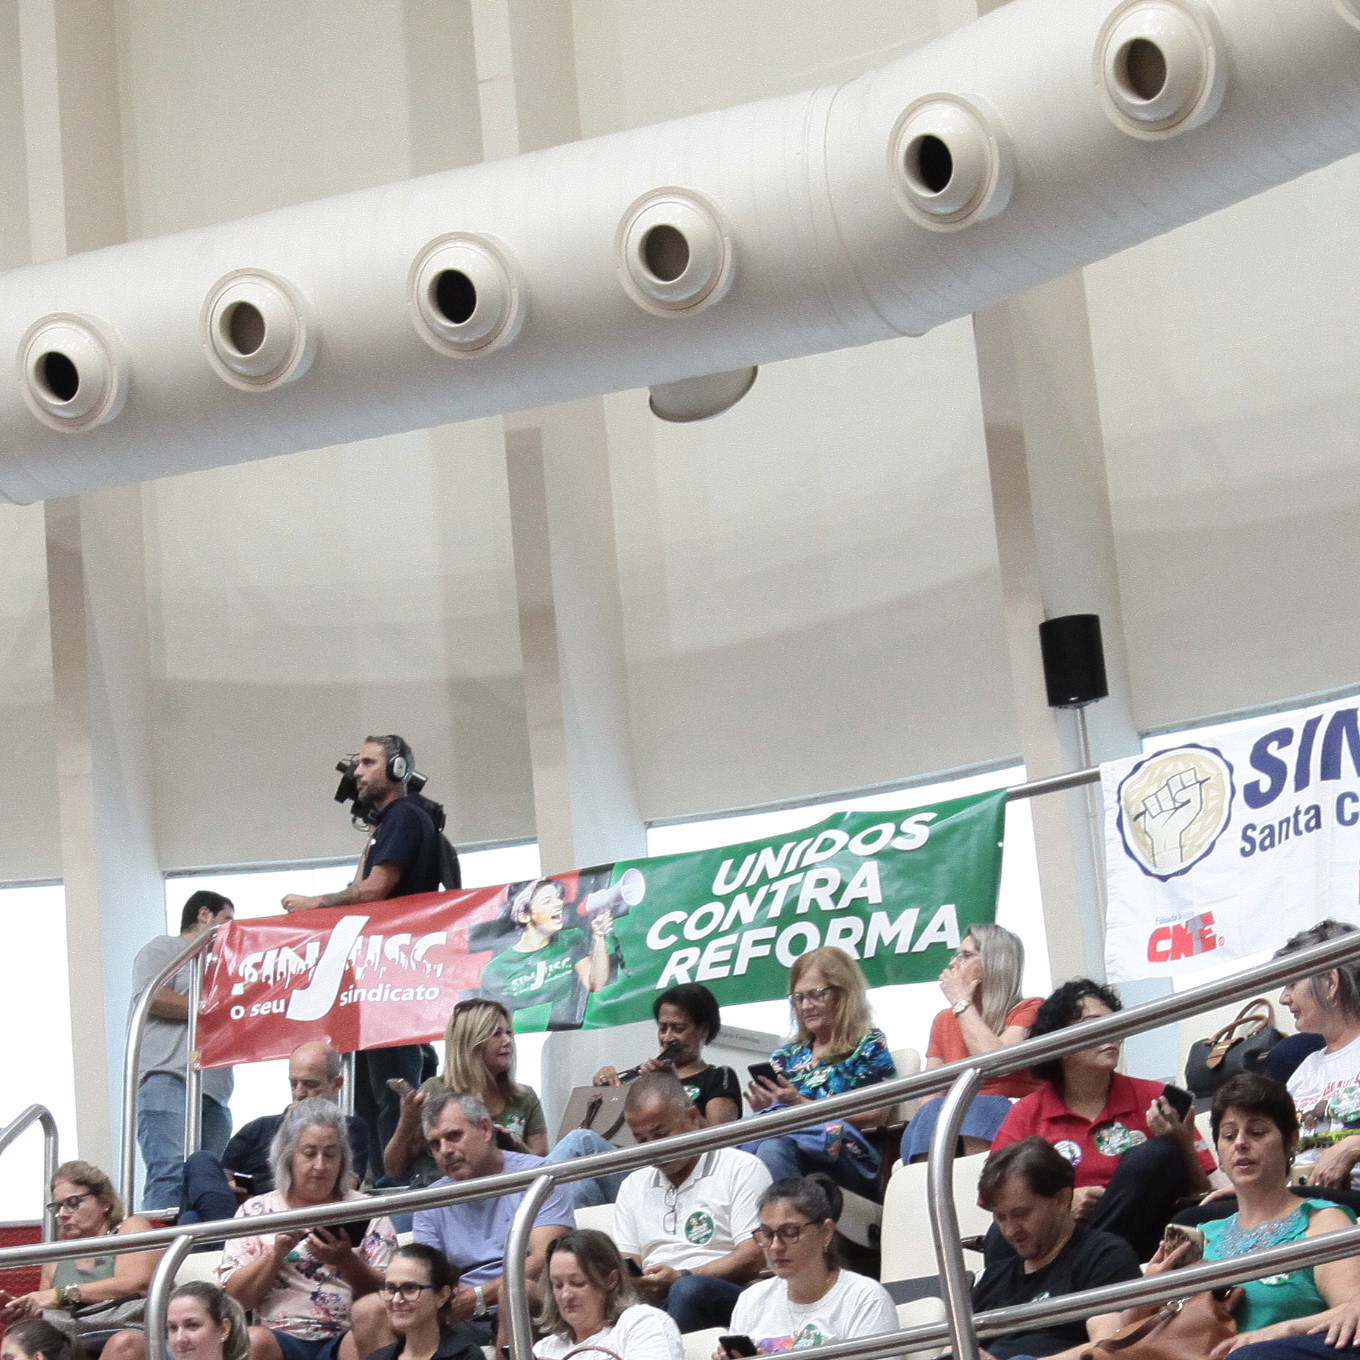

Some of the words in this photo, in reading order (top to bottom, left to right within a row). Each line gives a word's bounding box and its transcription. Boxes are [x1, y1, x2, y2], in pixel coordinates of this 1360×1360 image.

[712, 812, 938, 896] UNIDOS
[1240, 804, 1322, 858] Santa
[646, 861, 883, 950] CONTRA
[655, 904, 961, 990] REFORMA
[230, 1005, 245, 1020] o
[249, 998, 286, 1018] seu
[339, 983, 440, 1008] sindicato
